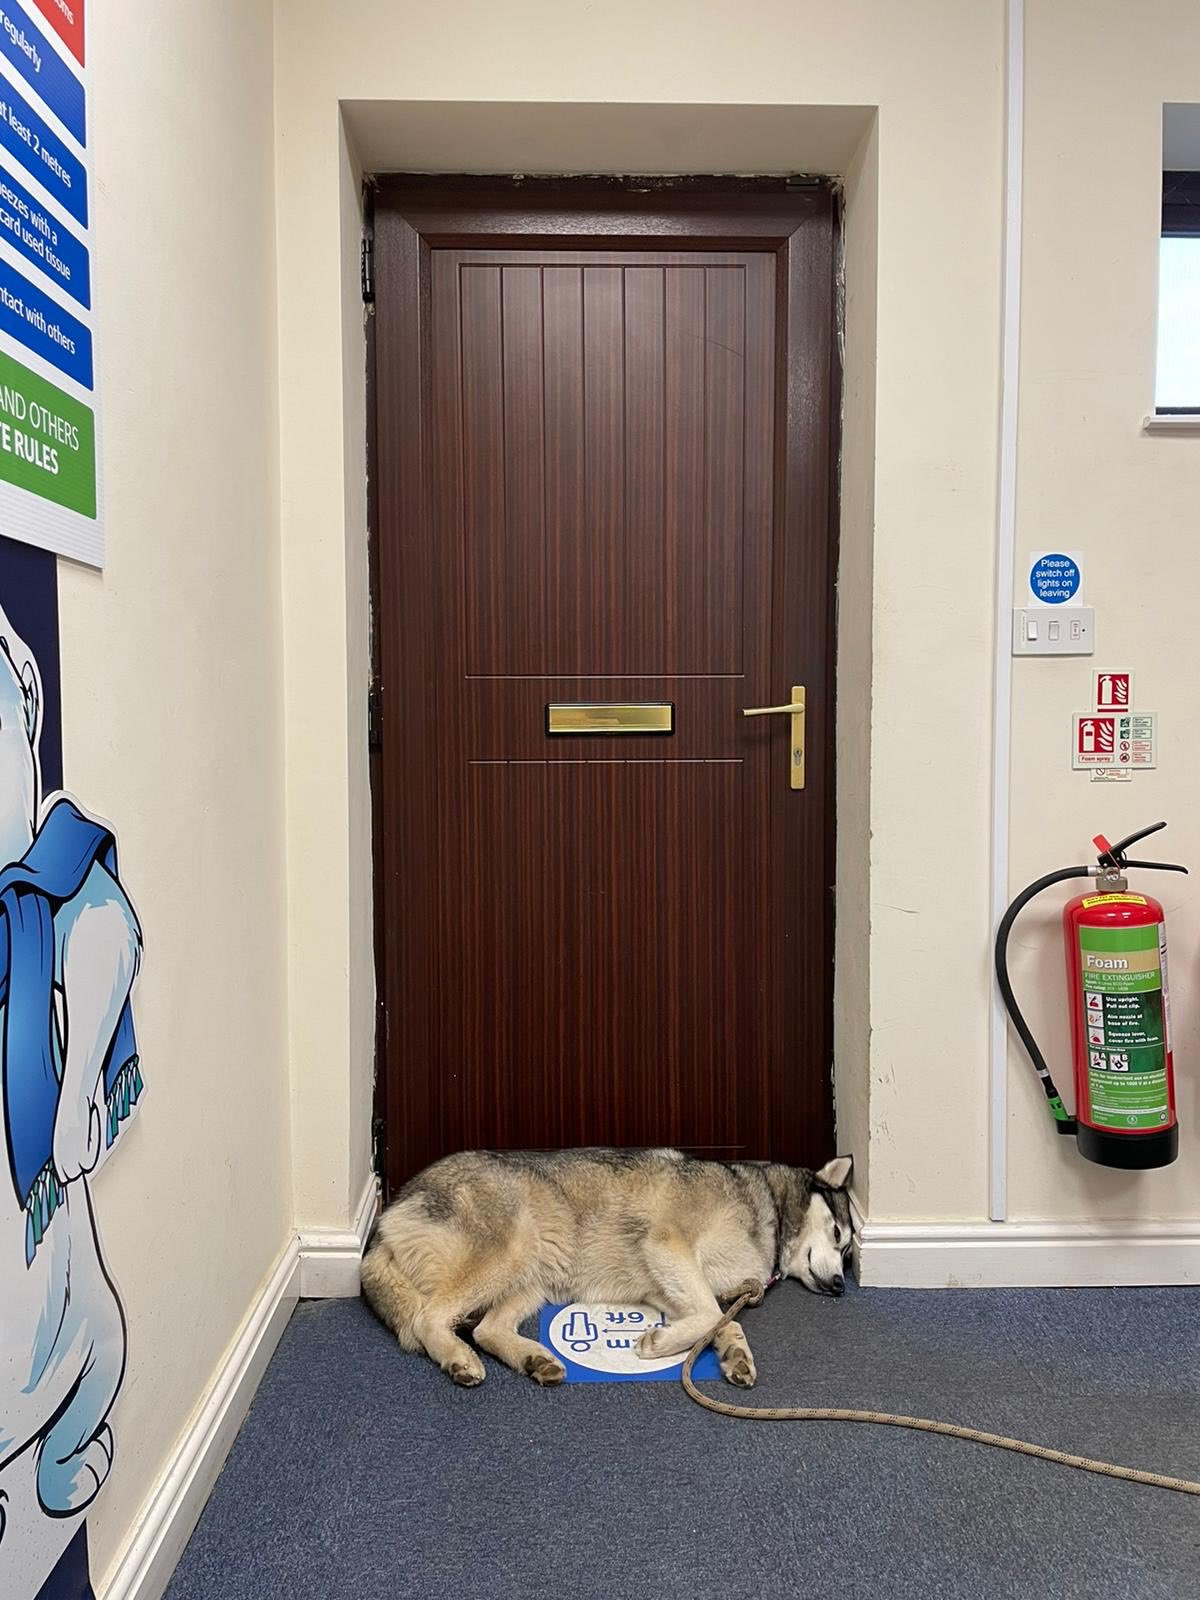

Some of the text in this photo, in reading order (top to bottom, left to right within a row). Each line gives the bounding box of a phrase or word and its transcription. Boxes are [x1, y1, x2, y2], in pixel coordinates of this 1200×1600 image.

[0, 9, 41, 73] regularly
[9, 106, 32, 147] least
[33, 134, 40, 155] 2
[41, 147, 72, 188] metres
[0, 182, 58, 246] eezes with a
[0, 207, 71, 280] card used tissue
[25, 307, 47, 333] with
[47, 324, 76, 354] others
[29, 401, 79, 451] OTHERS
[0, 421, 59, 475] E RULES
[1041, 559, 1070, 568] Please
[1035, 569, 1075, 577] switch off
[1037, 579, 1060, 589] lights
[1040, 589, 1070, 598] leaving
[1087, 955, 1128, 969] Foam
[1084, 971, 1155, 981] FIRE EXTINGUISHER
[605, 1311, 644, 1324] 6ft
[606, 1339, 630, 1349] m
